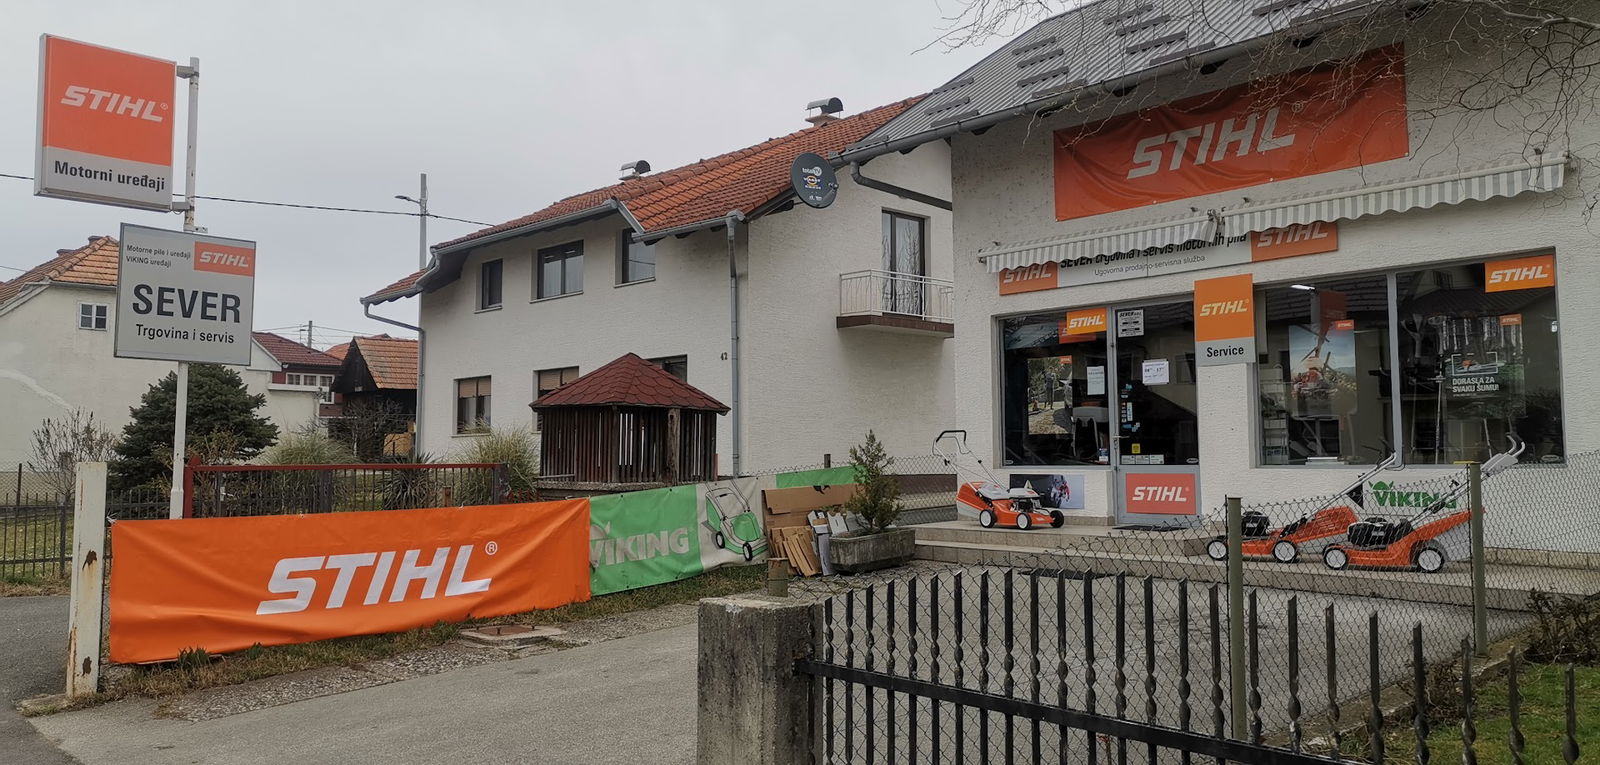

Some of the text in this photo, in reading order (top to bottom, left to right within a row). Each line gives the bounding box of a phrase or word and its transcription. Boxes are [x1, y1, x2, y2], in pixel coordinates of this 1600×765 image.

[61, 85, 163, 122] STIHL
[1127, 107, 1295, 179] STIHL
[55, 160, 165, 192] Motorni uređaji
[1257, 222, 1329, 247] STIHL
[126, 245, 152, 254] Motorne
[170, 251, 191, 260] uređaji
[1143, 244, 1174, 257] servis
[126, 256, 172, 268] VIKING uređaji
[200, 252, 249, 268] STIHL
[1183, 255, 1206, 264] služba
[1003, 263, 1052, 284] STIHL
[1489, 266, 1548, 283] STIHL
[132, 284, 240, 323] SEVER
[1200, 300, 1247, 316] STIHL
[1069, 315, 1104, 328] STIHL
[136, 324, 234, 343] Trgovina i servis
[720, 351, 728, 360] 42
[1206, 345, 1244, 357] Service
[1132, 487, 1187, 502] STIHL
[256, 544, 492, 616] STIHL
